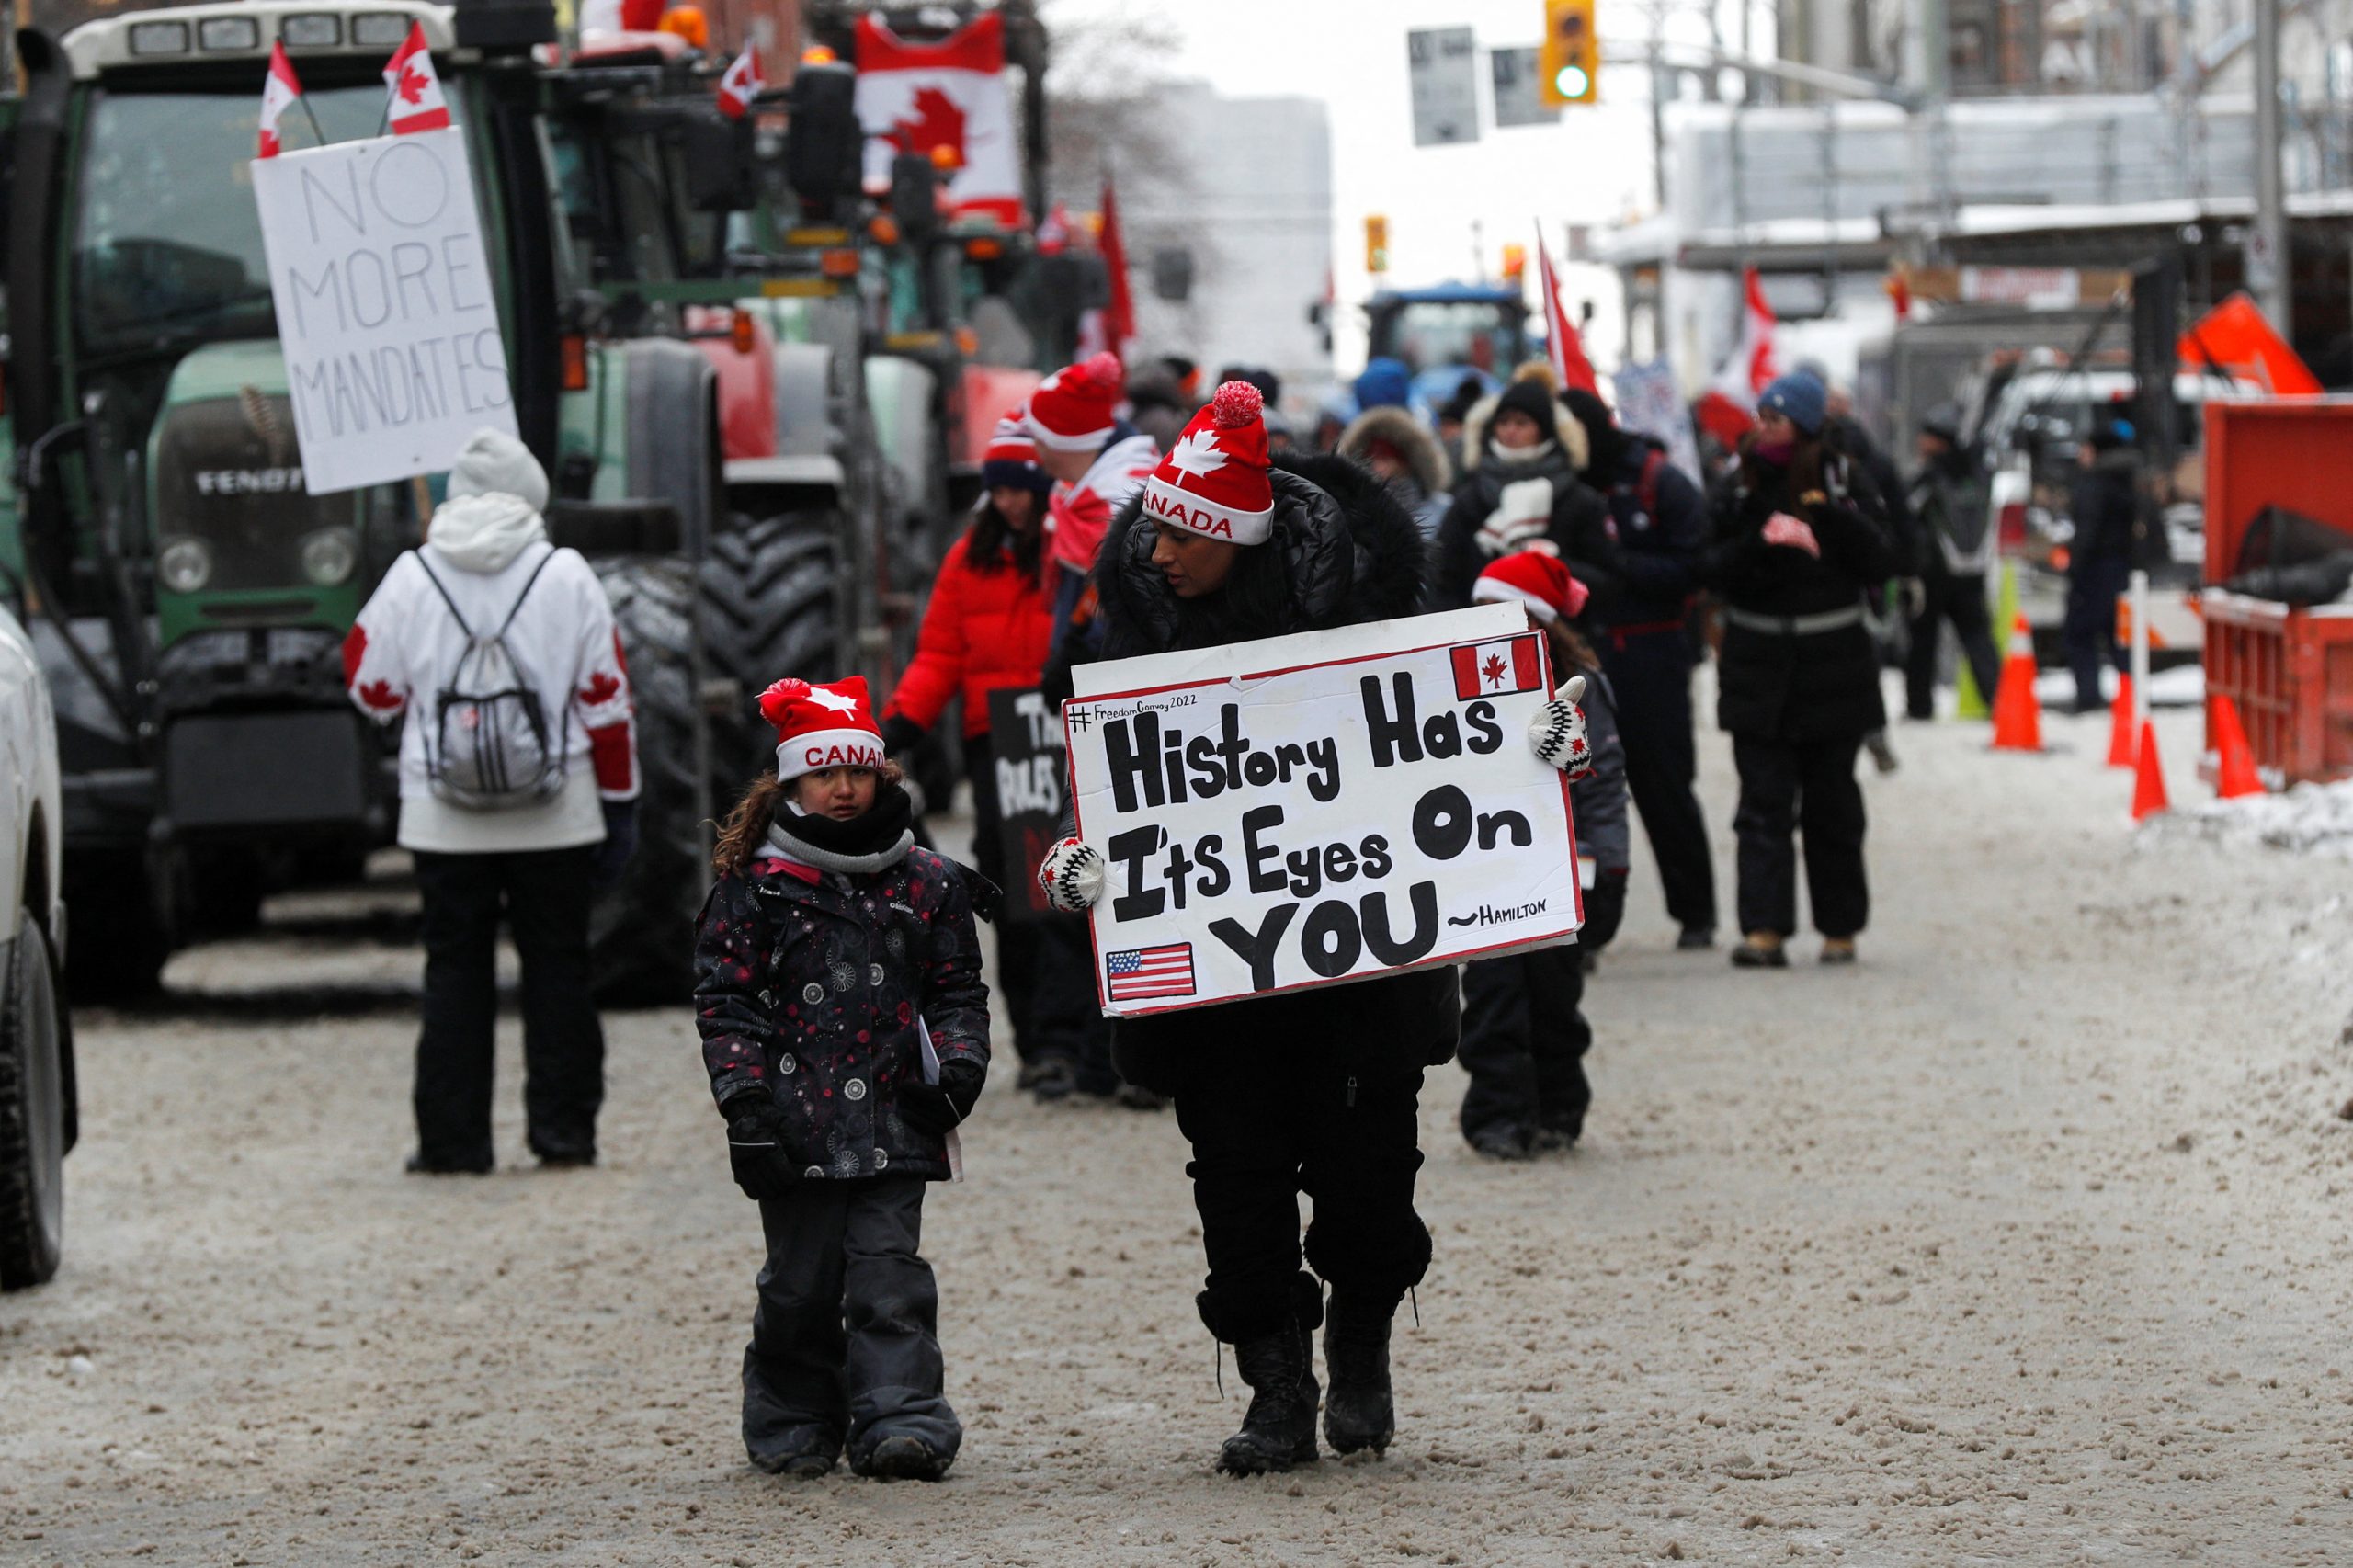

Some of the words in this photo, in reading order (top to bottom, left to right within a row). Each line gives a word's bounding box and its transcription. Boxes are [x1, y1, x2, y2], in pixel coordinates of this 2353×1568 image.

[301, 142, 450, 244] NO
[288, 233, 486, 339] MORE
[293, 327, 509, 442] MANDATES
[1103, 703, 1341, 812] History
[1360, 671, 1504, 767] Has
[1242, 804, 1392, 898] Eyes
[1412, 784, 1532, 860] On
[1208, 880, 1439, 991] YOU
